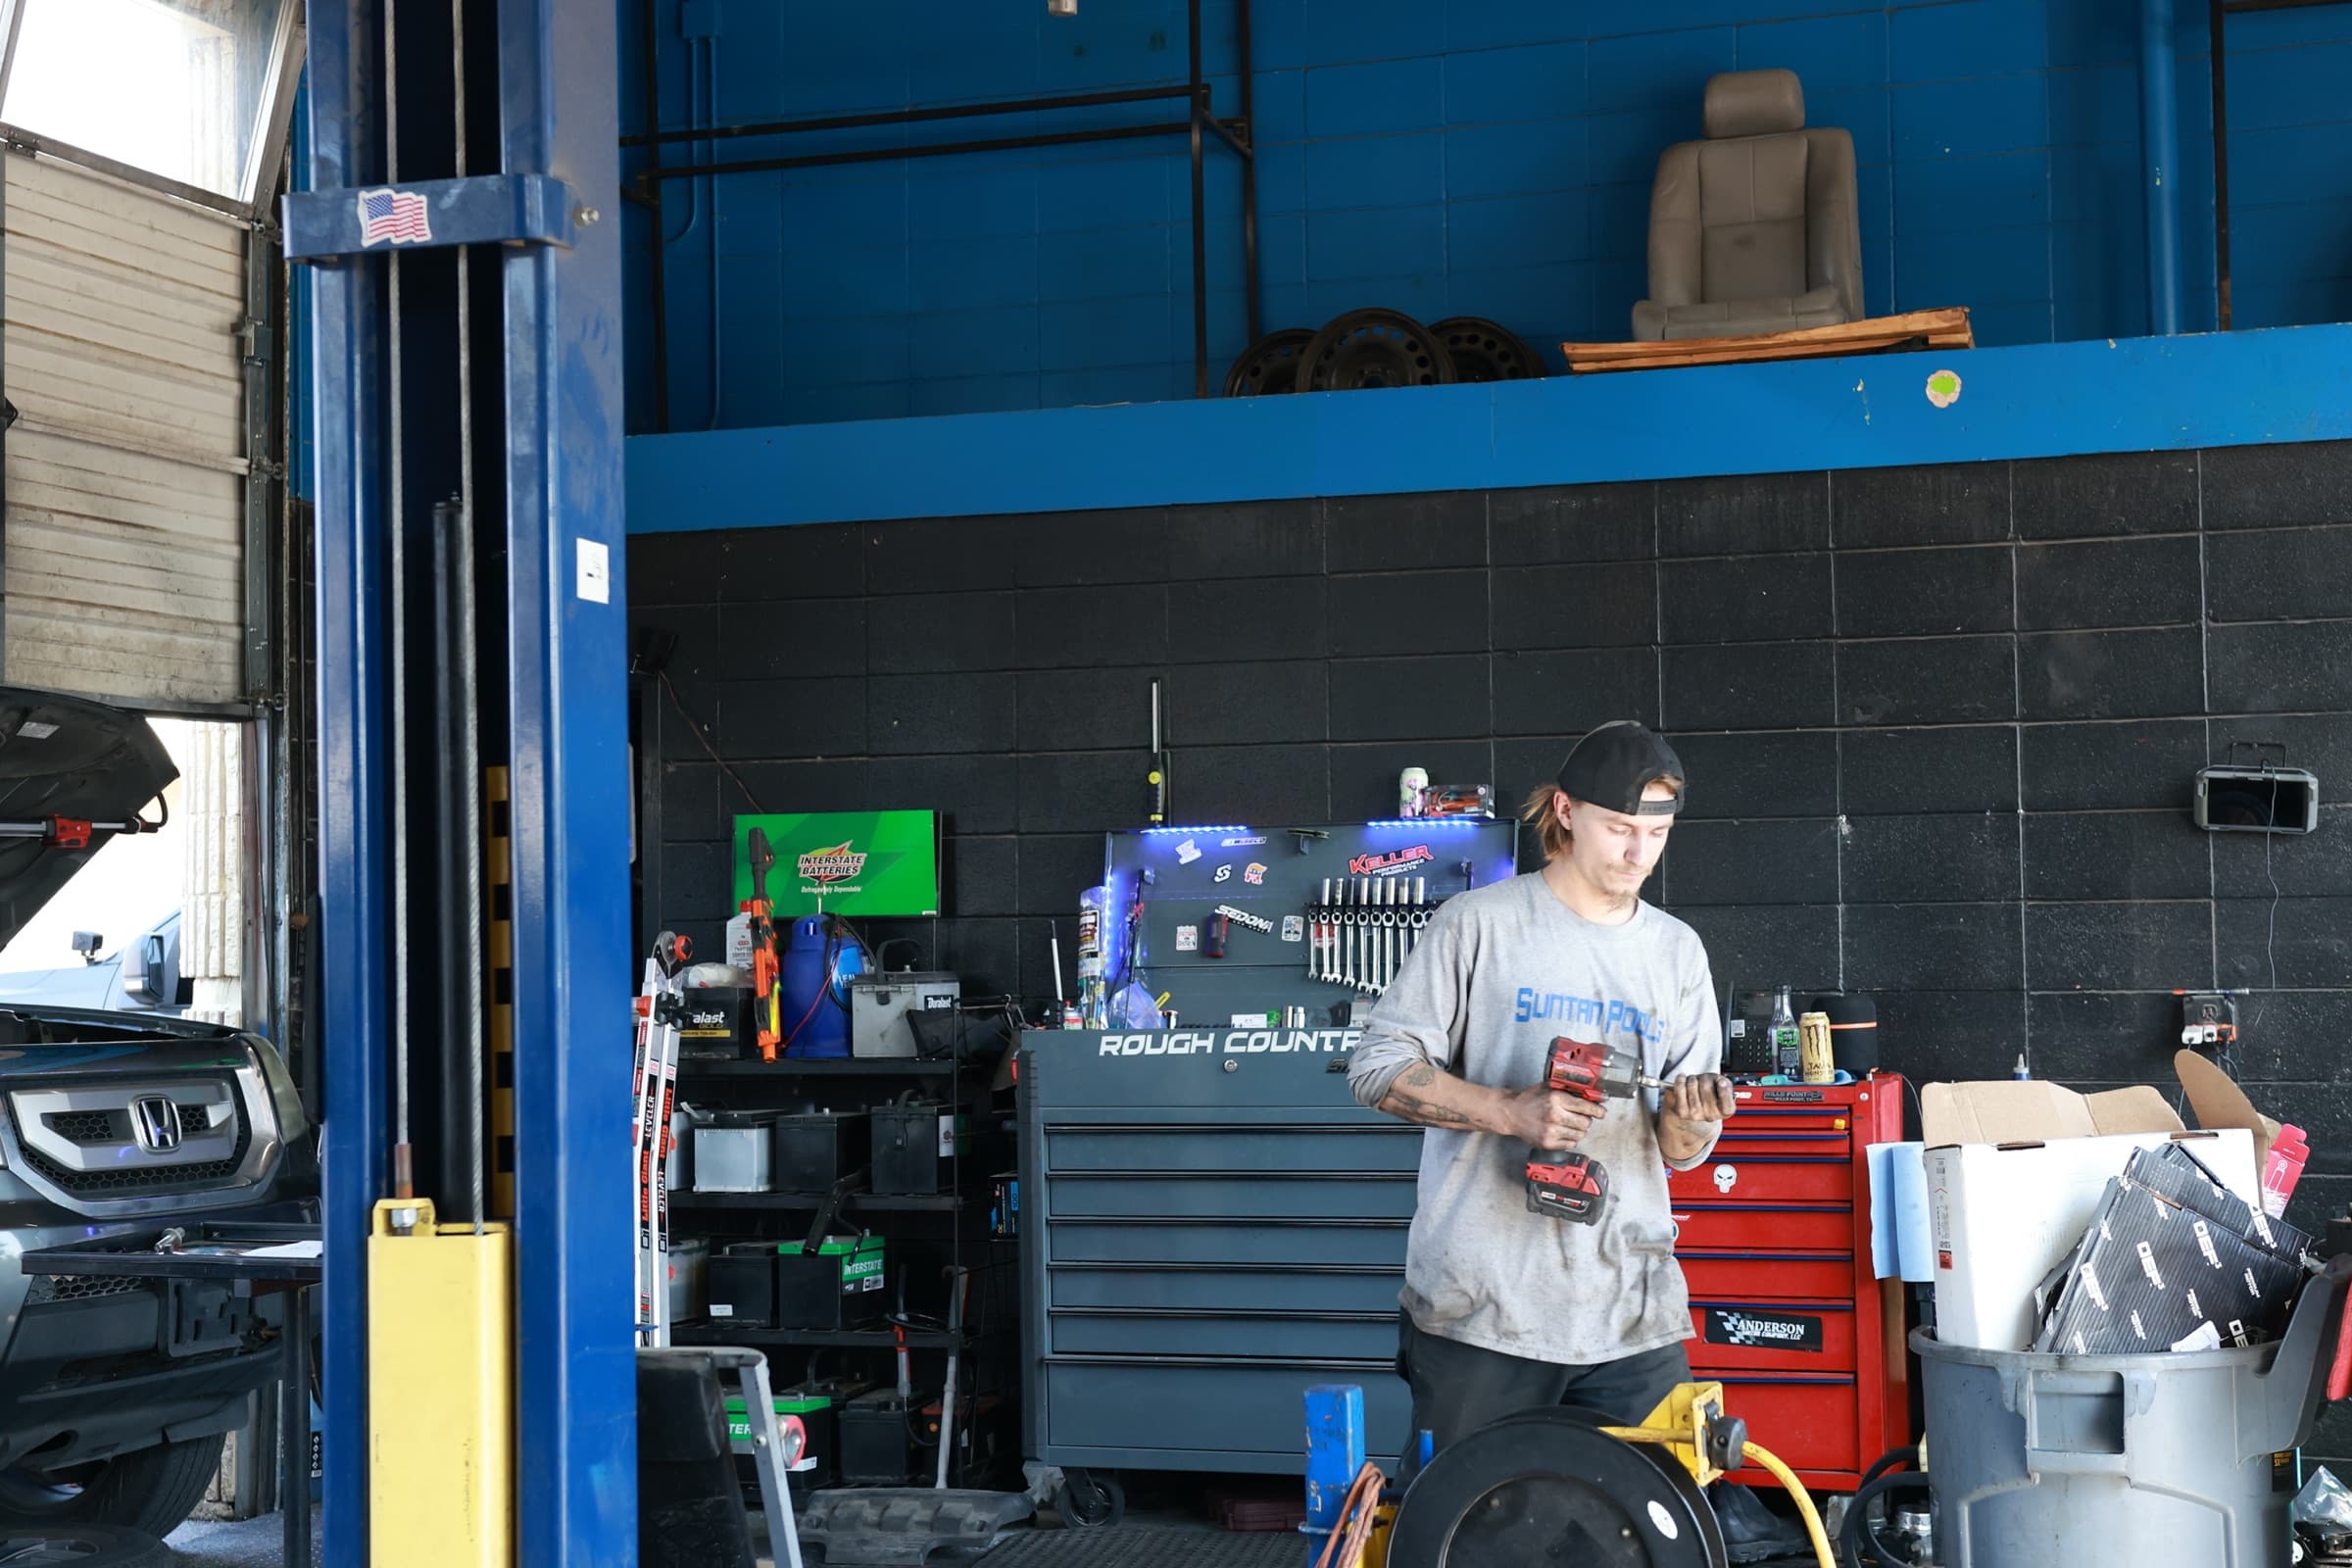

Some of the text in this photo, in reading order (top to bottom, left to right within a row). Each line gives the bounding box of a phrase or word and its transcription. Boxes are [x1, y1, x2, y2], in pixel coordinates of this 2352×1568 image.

[801, 856, 862, 864] INTERSTATE
[803, 866, 858, 875] BATTERIES
[1349, 845, 1434, 874] KELLER
[1215, 905, 1273, 933] SEDONA
[1099, 1033, 1215, 1055] ROUGH
[645, 1096, 655, 1138] LEVELER
[662, 1088, 673, 1122] Little
[659, 1125, 668, 1158] Giant
[844, 1258, 882, 1275] INTERSTATE
[1737, 1319, 1805, 1335] ANDERSON
